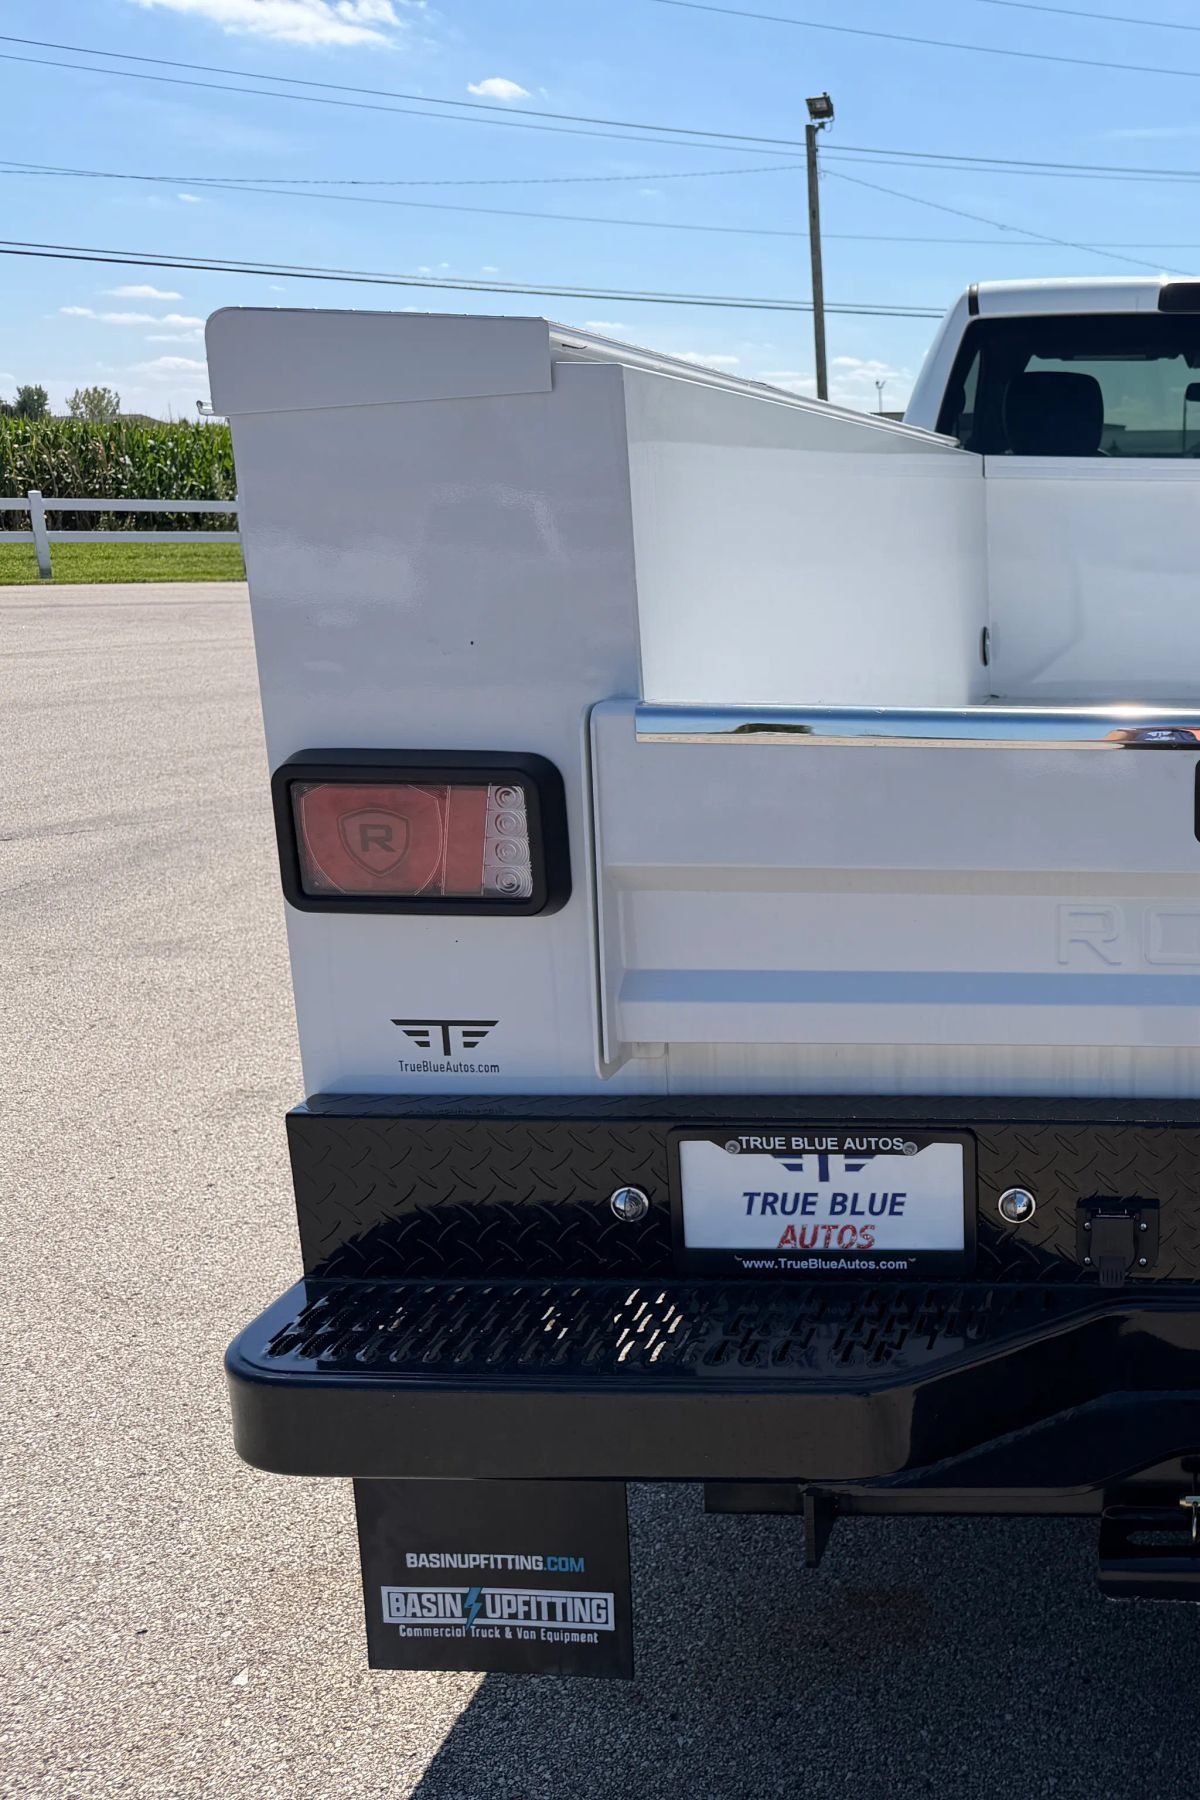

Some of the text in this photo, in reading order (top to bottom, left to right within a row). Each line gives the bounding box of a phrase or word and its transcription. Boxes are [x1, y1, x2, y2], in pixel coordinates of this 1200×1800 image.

[360, 824, 396, 852] R
[398, 1060, 500, 1073] TrueBlueAutos.com
[738, 1136, 904, 1151] TRUE BLUE AUTOS
[742, 1192, 907, 1217] TRUE BLUE
[777, 1223, 876, 1249] AUTOS
[742, 1257, 908, 1270] www.TrueBlueAutos.com
[405, 1553, 585, 1573] BASINUPFITTING.COM
[389, 1592, 607, 1624] BASIN UPFITTING
[399, 1624, 599, 1644] Commercial Truck & Van Equipment
